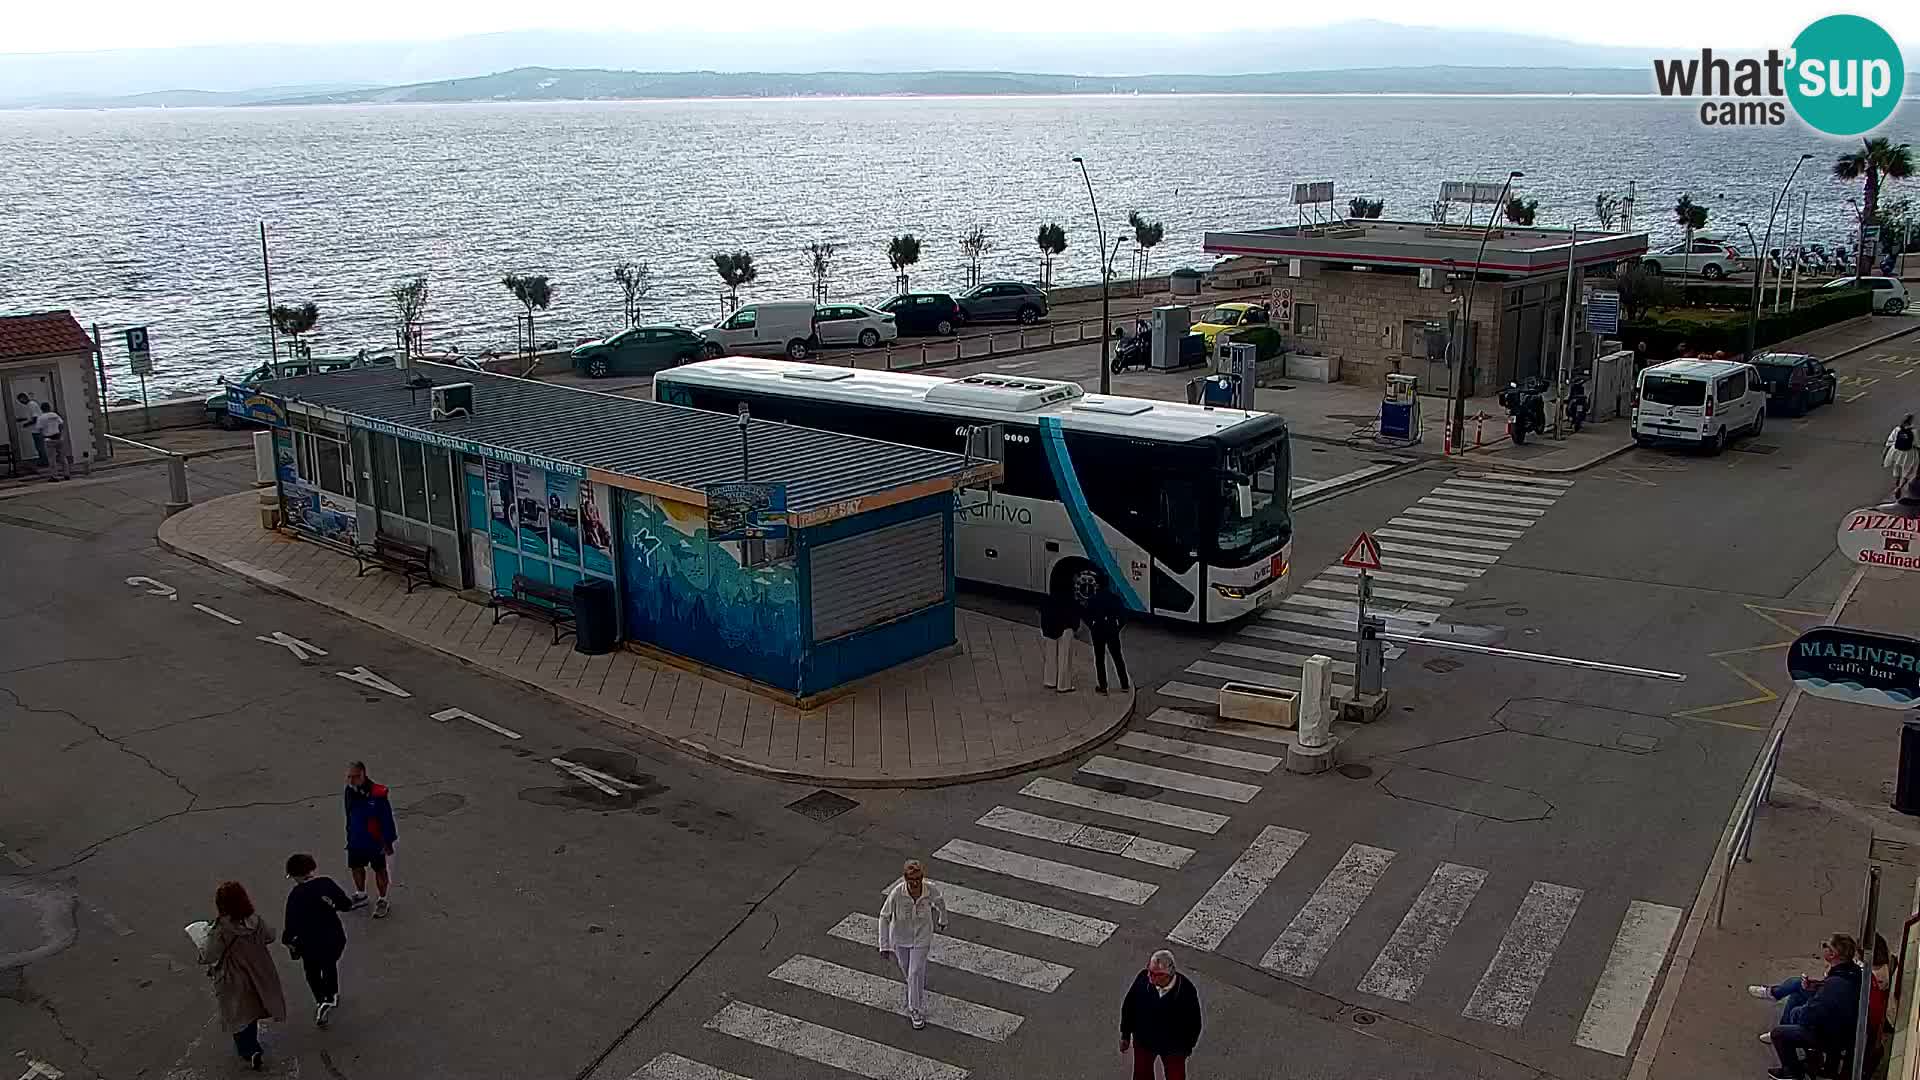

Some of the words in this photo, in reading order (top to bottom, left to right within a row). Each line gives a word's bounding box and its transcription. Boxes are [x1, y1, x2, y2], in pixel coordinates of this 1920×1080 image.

[437, 436, 468, 452] POSTAJA
[479, 445, 494, 457] BUS
[495, 449, 527, 465] STATION
[529, 456, 555, 471] TICKET
[556, 461, 583, 477] OFFICE
[970, 500, 1032, 525] arriva
[1848, 515, 1920, 532] PIZZE
[1800, 641, 1920, 673] MARINER
[1828, 662, 1865, 675] caffe
[1870, 665, 1896, 680] bar
